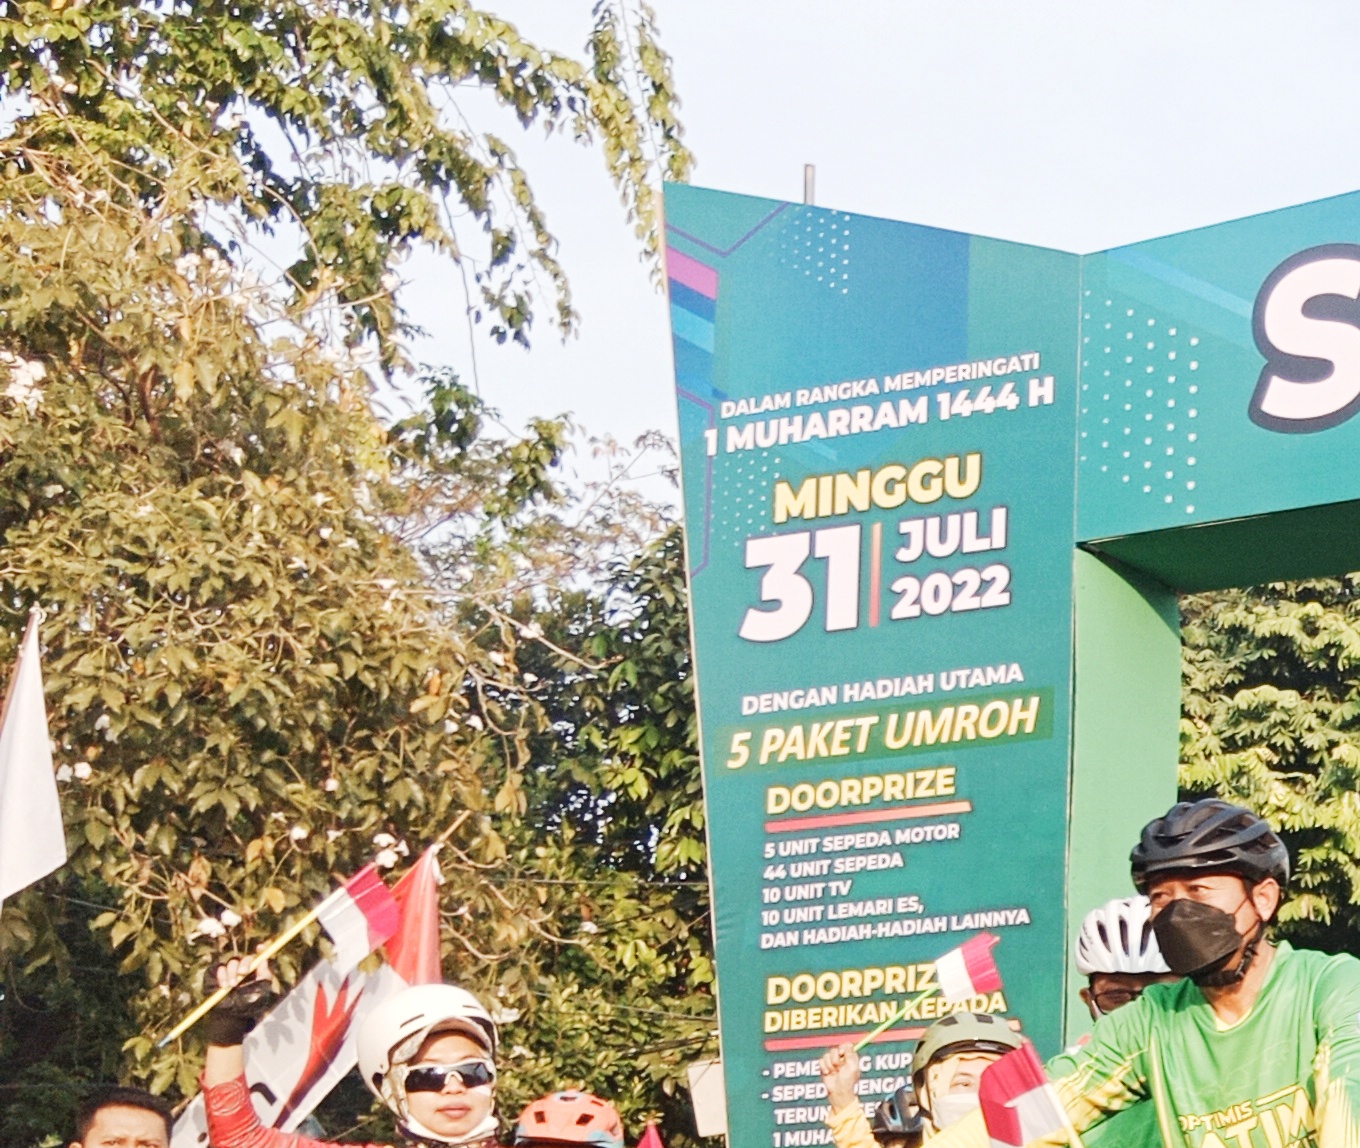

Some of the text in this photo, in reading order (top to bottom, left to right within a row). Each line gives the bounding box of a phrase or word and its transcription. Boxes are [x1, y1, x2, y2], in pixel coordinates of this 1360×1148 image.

[720, 351, 1041, 420] DALAM RANGKA MEMPERINGATI
[704, 376, 1056, 456] 1 MUHARRAM 1444 H
[773, 453, 983, 524] MINGGU
[737, 506, 1008, 643] 31 JULI
[889, 563, 1012, 621] 2022
[741, 663, 1024, 716] DENGAN HADIAH UTAMA
[726, 696, 1041, 770] 5 PAKET UMROH
[766, 767, 957, 816] DOORPRIZE
[763, 823, 961, 858] 5 UNIT SEPEDA MOTOR
[762, 852, 904, 880] 44 UNIT SEPEDA
[761, 895, 925, 926] 10 UNIT LEMARI ES,
[762, 880, 852, 904] 10 UNIT TV
[760, 908, 1031, 950] DAN HADIAH-HADIAH LAINNYA
[766, 962, 938, 1006] DOORPRIZ
[763, 991, 1008, 1033] DIBERIKAN KEPADA
[773, 1055, 872, 1079] PEMEG
[875, 1052, 913, 1071] KUP
[772, 1083, 830, 1103] SEPED
[784, 1129, 835, 1148] MUHA
